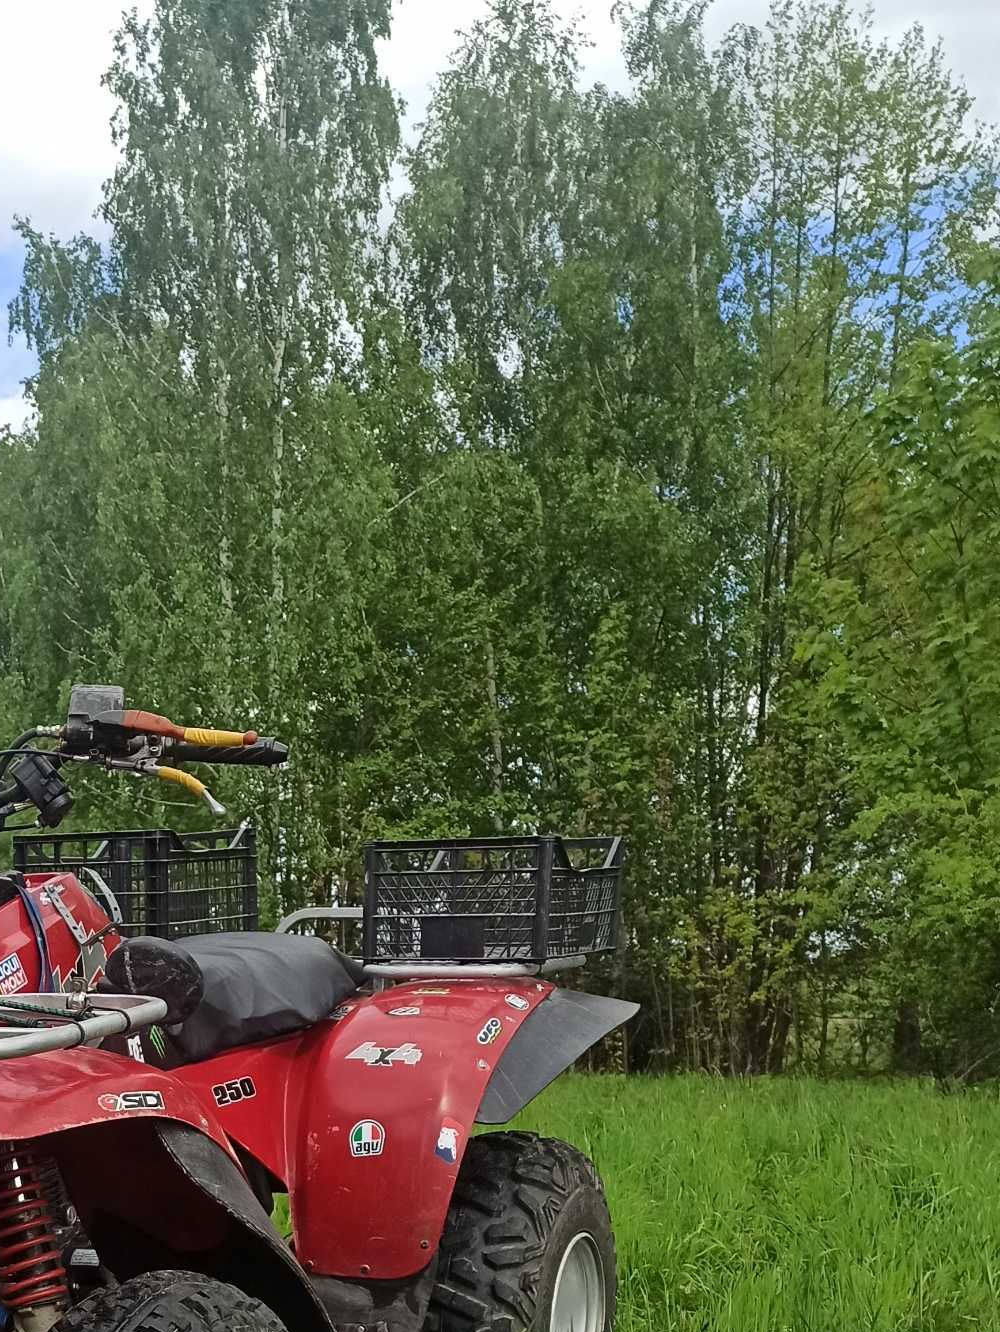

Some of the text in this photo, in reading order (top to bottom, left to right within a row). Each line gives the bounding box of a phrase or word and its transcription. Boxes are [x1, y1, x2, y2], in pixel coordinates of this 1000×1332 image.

[0, 970, 24, 994] MOLY
[478, 1018, 500, 1043] UFO
[213, 1077, 256, 1106] 250
[355, 1140, 380, 1154] agv
